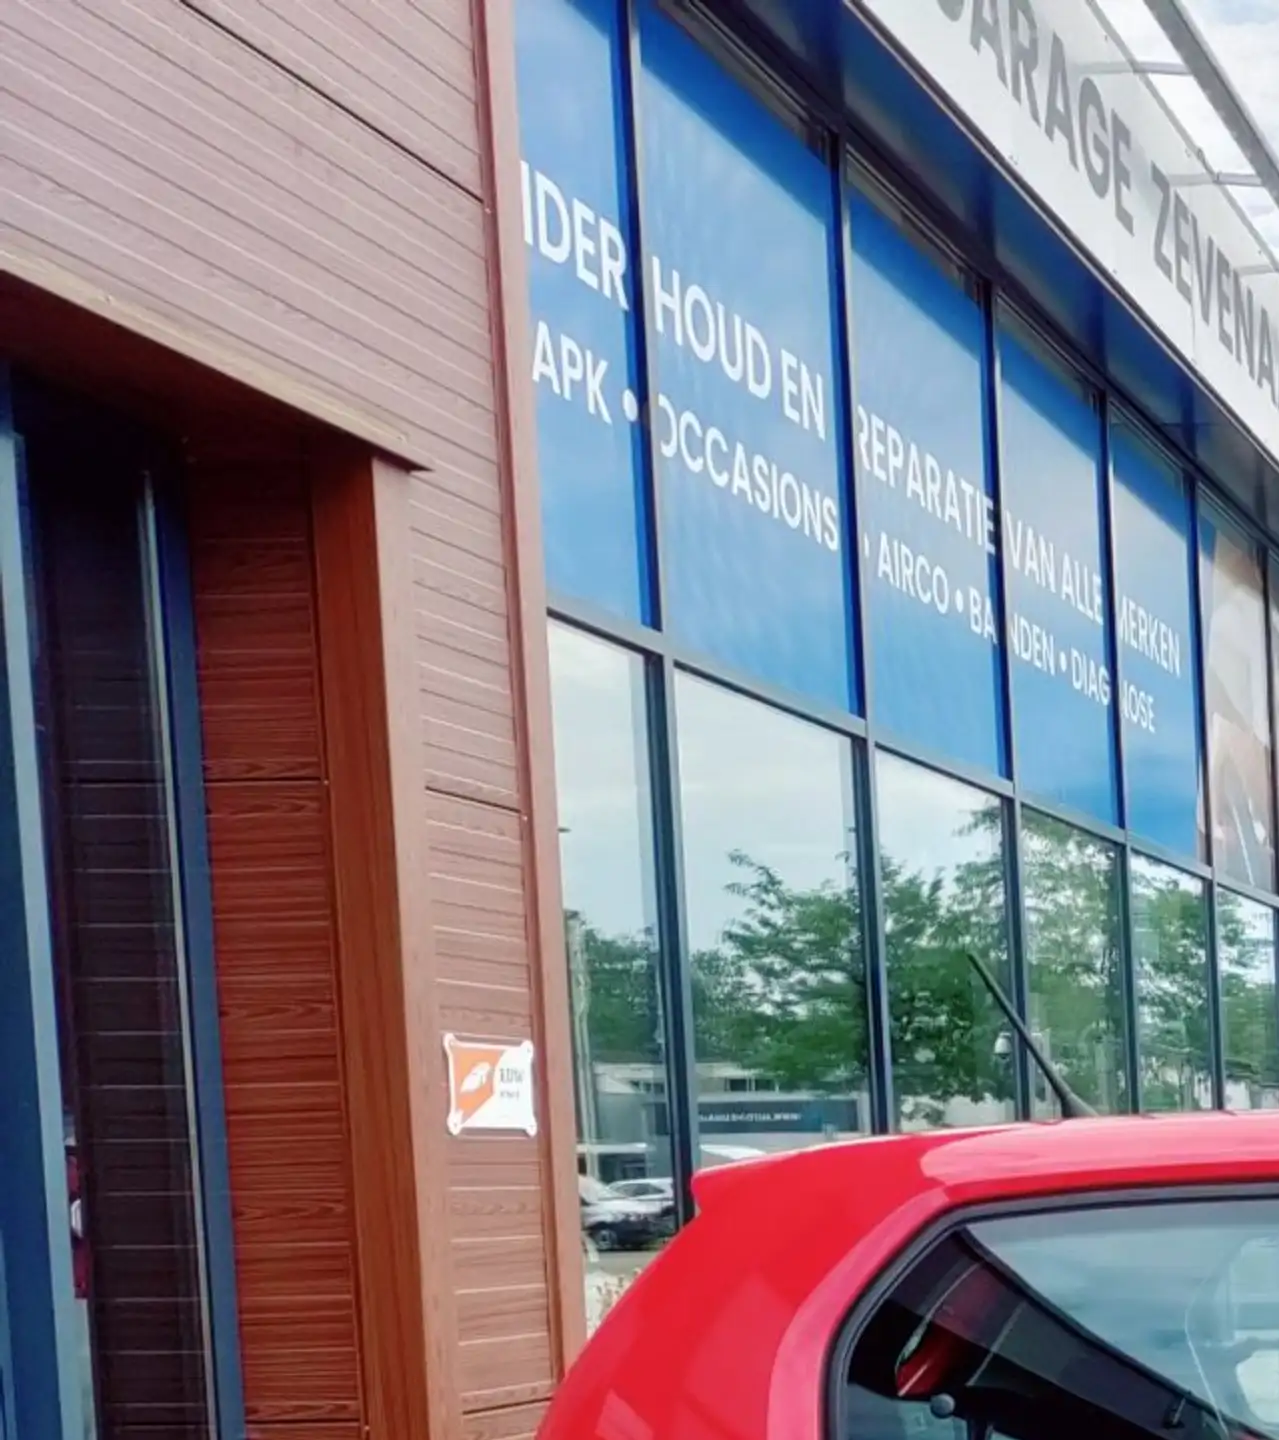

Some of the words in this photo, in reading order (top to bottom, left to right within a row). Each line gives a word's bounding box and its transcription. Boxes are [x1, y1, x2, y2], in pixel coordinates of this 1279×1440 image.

[938, 0, 1134, 237] ARAGE
[531, 320, 612, 425] APK
[877, 531, 949, 616] AIRCO
[781, 348, 827, 442] EN
[1004, 509, 1057, 593] VAN
[1061, 552, 1104, 626] ALLE
